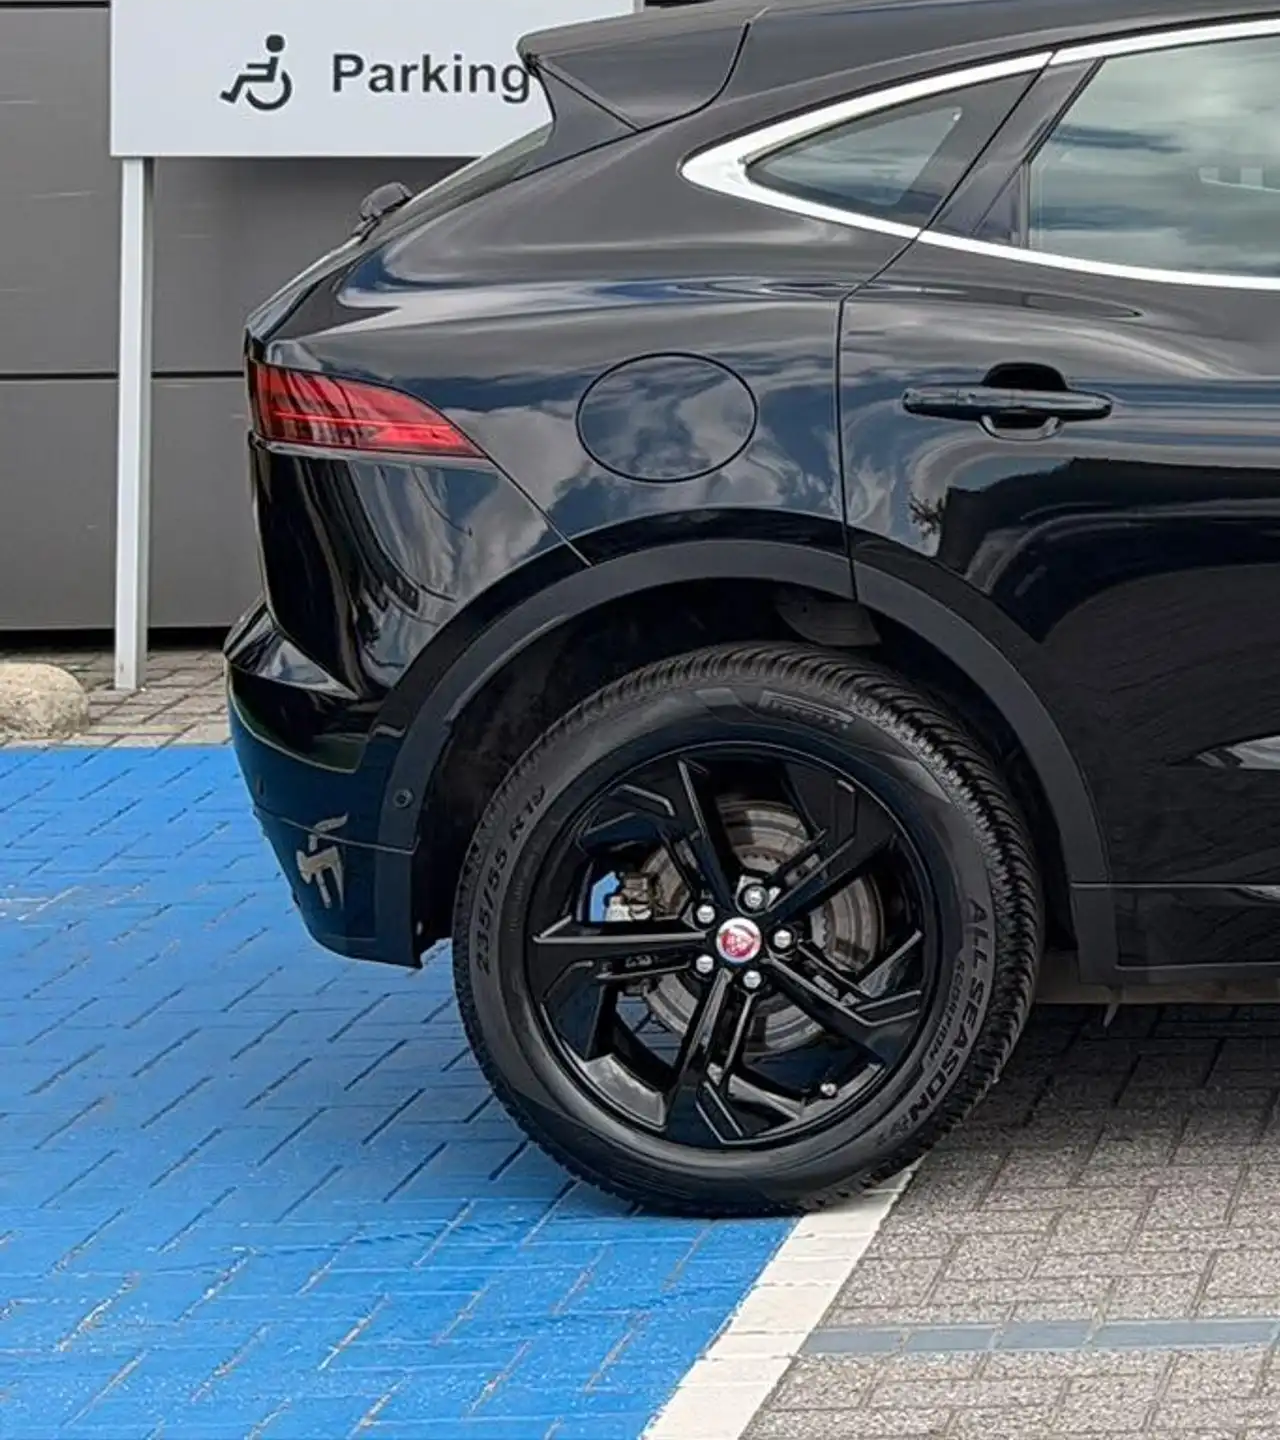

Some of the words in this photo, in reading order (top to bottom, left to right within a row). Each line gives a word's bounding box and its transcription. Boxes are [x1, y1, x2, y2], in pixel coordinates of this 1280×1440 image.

[332, 53, 530, 104] Parking
[966, 897, 989, 969] ALL
[907, 975, 985, 1123] SEASON
